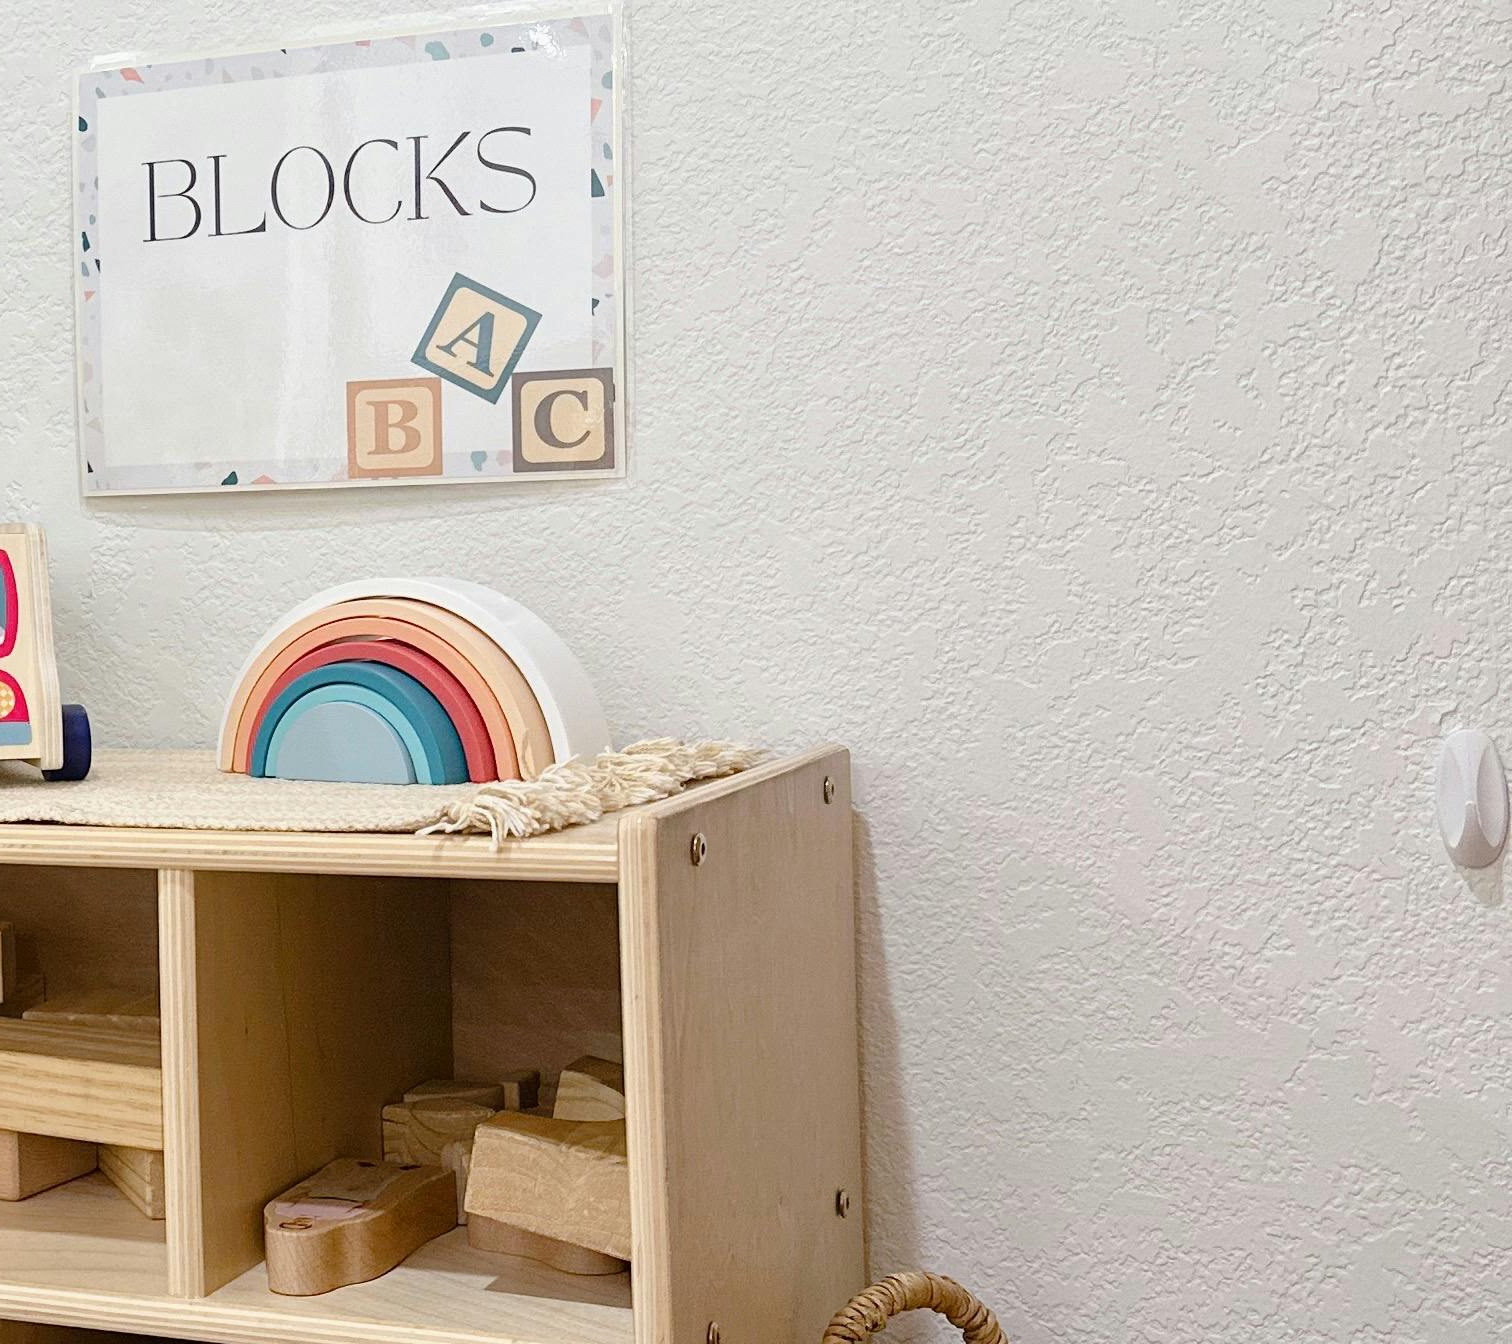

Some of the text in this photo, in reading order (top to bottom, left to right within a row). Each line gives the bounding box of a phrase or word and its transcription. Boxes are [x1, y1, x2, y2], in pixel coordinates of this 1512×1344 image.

[140, 126, 537, 243] BLOCKS
[436, 311, 496, 378] A
[364, 389, 591, 456] B C
